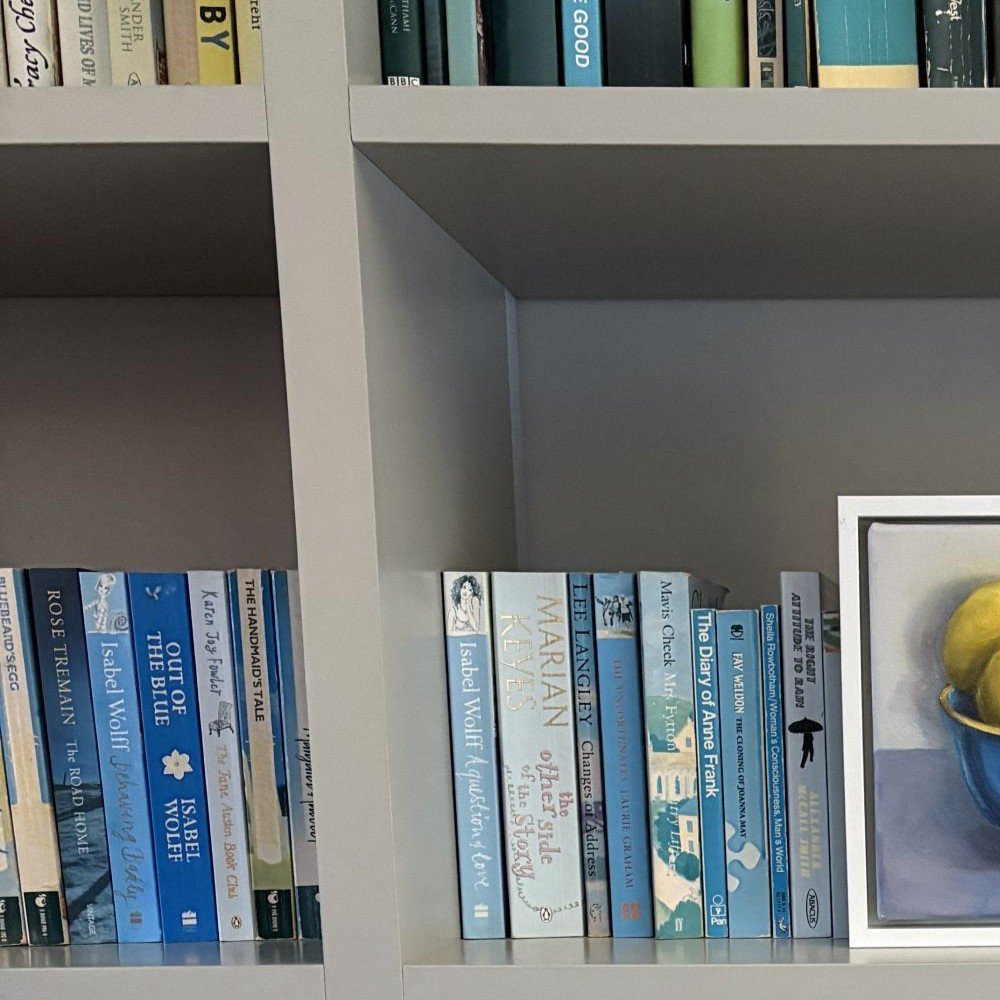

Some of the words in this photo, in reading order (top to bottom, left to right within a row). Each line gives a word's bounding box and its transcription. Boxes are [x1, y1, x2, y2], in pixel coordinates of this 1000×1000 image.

[79, 16, 95, 56] LIVES
[119, 6, 133, 52] SMITH
[573, 9, 591, 68] GOOD
[201, 588, 220, 626] Karen
[244, 579, 257, 604] THE
[659, 580, 673, 620] Mavis
[47, 590, 66, 638] ROSE
[698, 612, 713, 644] The
[146, 631, 164, 675] THE
[166, 642, 184, 683] OUT
[247, 606, 264, 688] HANDMAID'S
[459, 641, 482, 693] Isabel
[499, 612, 537, 712] KEYES
[536, 594, 570, 729] MARIAN
[661, 624, 677, 667] Cheek
[698, 645, 715, 689] Diary
[732, 652, 745, 672] FAY
[53, 644, 76, 726] TREMAIN
[101, 642, 124, 694] Isabel
[575, 628, 594, 727] LANGLEY
[152, 681, 170, 727] BLUE
[169, 688, 187, 715] OF
[253, 688, 265, 723] TALE
[701, 689, 716, 707] of
[702, 709, 718, 750] Anne
[65, 740, 79, 764] The
[579, 739, 597, 799] Changes
[68, 767, 85, 807] ROAD
[704, 753, 719, 798] Frank
[73, 811, 89, 855] HOME
[163, 798, 182, 864] WOLFF
[180, 798, 201, 863] ISABEL
[583, 822, 600, 877] Address
[86, 903, 96, 936] VINTAGE
[806, 893, 818, 924] ABACUS
